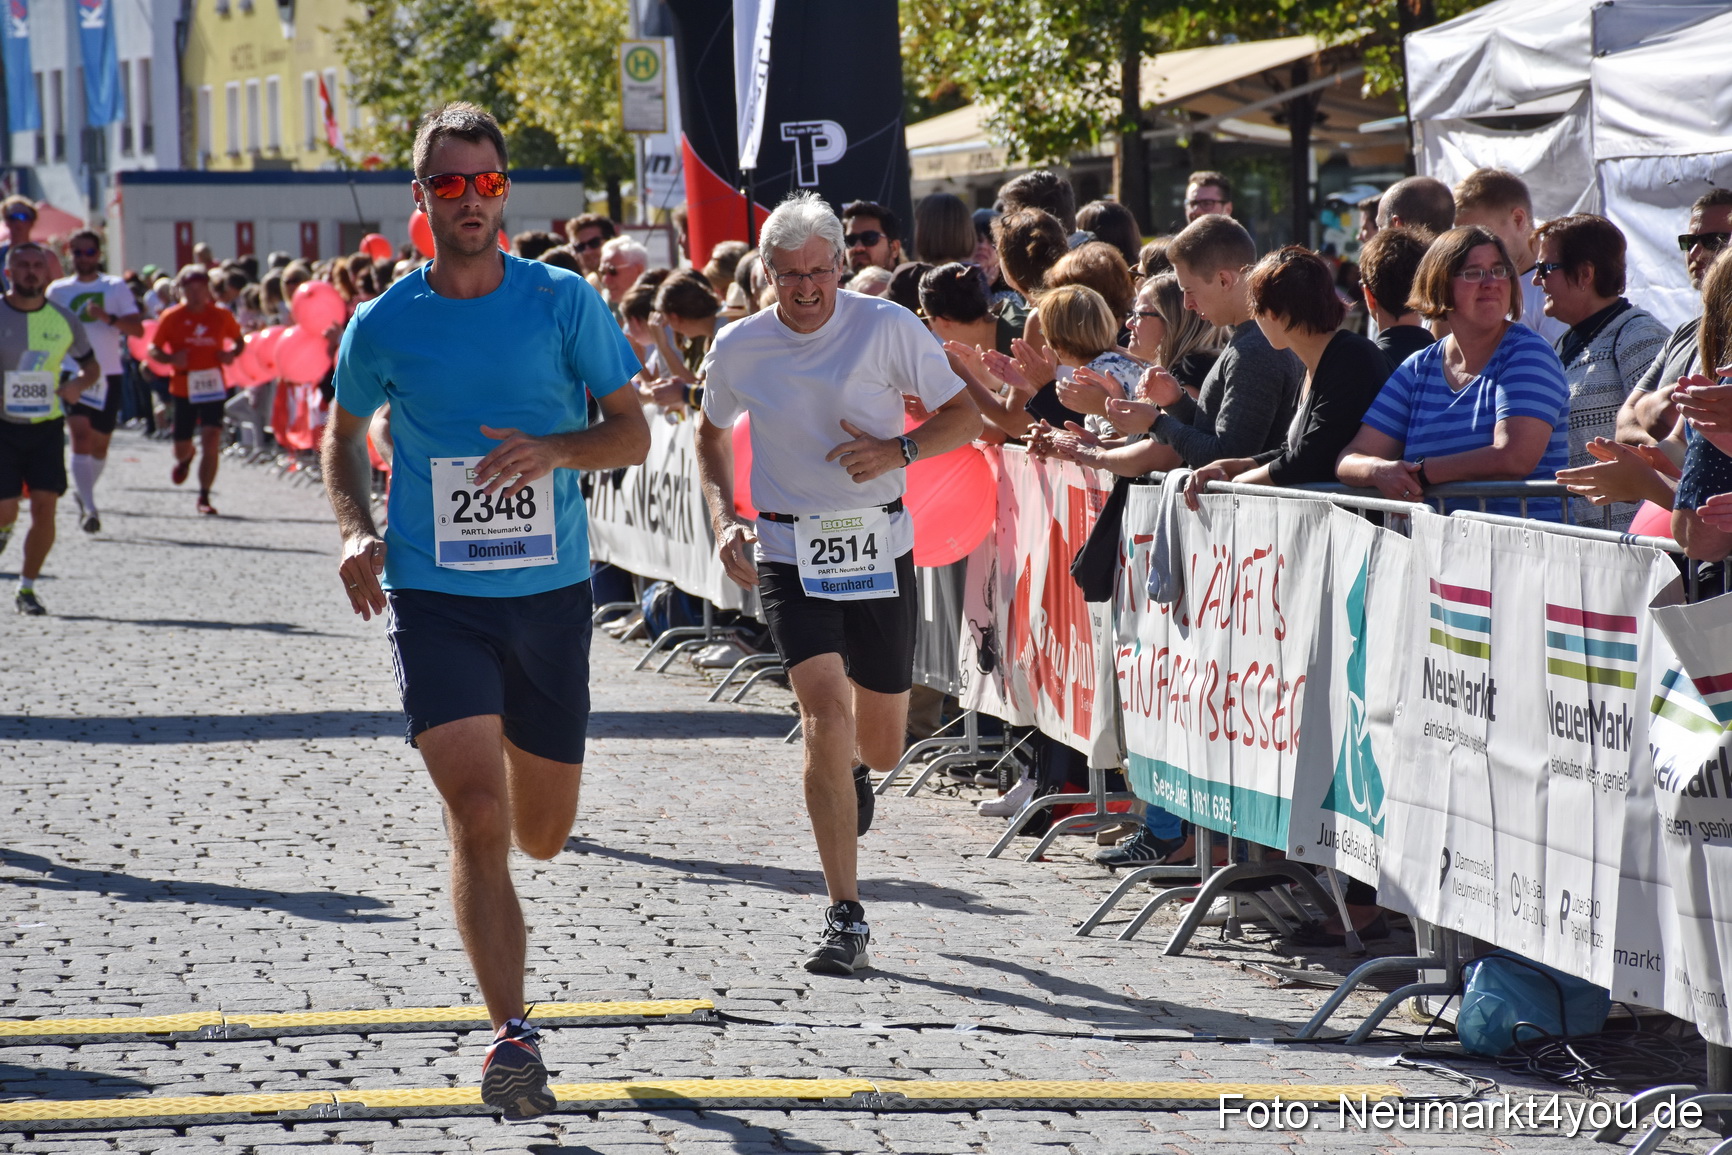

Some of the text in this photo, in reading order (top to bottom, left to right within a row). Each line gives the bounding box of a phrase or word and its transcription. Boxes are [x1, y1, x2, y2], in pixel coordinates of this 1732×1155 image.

[12, 384, 47, 398] 2888
[451, 486, 537, 524] 2348
[461, 525, 522, 536] PARTL Neumarkt
[821, 516, 864, 530] BOCK
[468, 540, 526, 558] Dominik
[810, 532, 878, 566] 2514
[818, 566, 867, 575] PARTL Neumarkt
[821, 577, 874, 592] Bernhard
[1551, 754, 1583, 780] einkaufen
[1316, 822, 1340, 850] Jura
